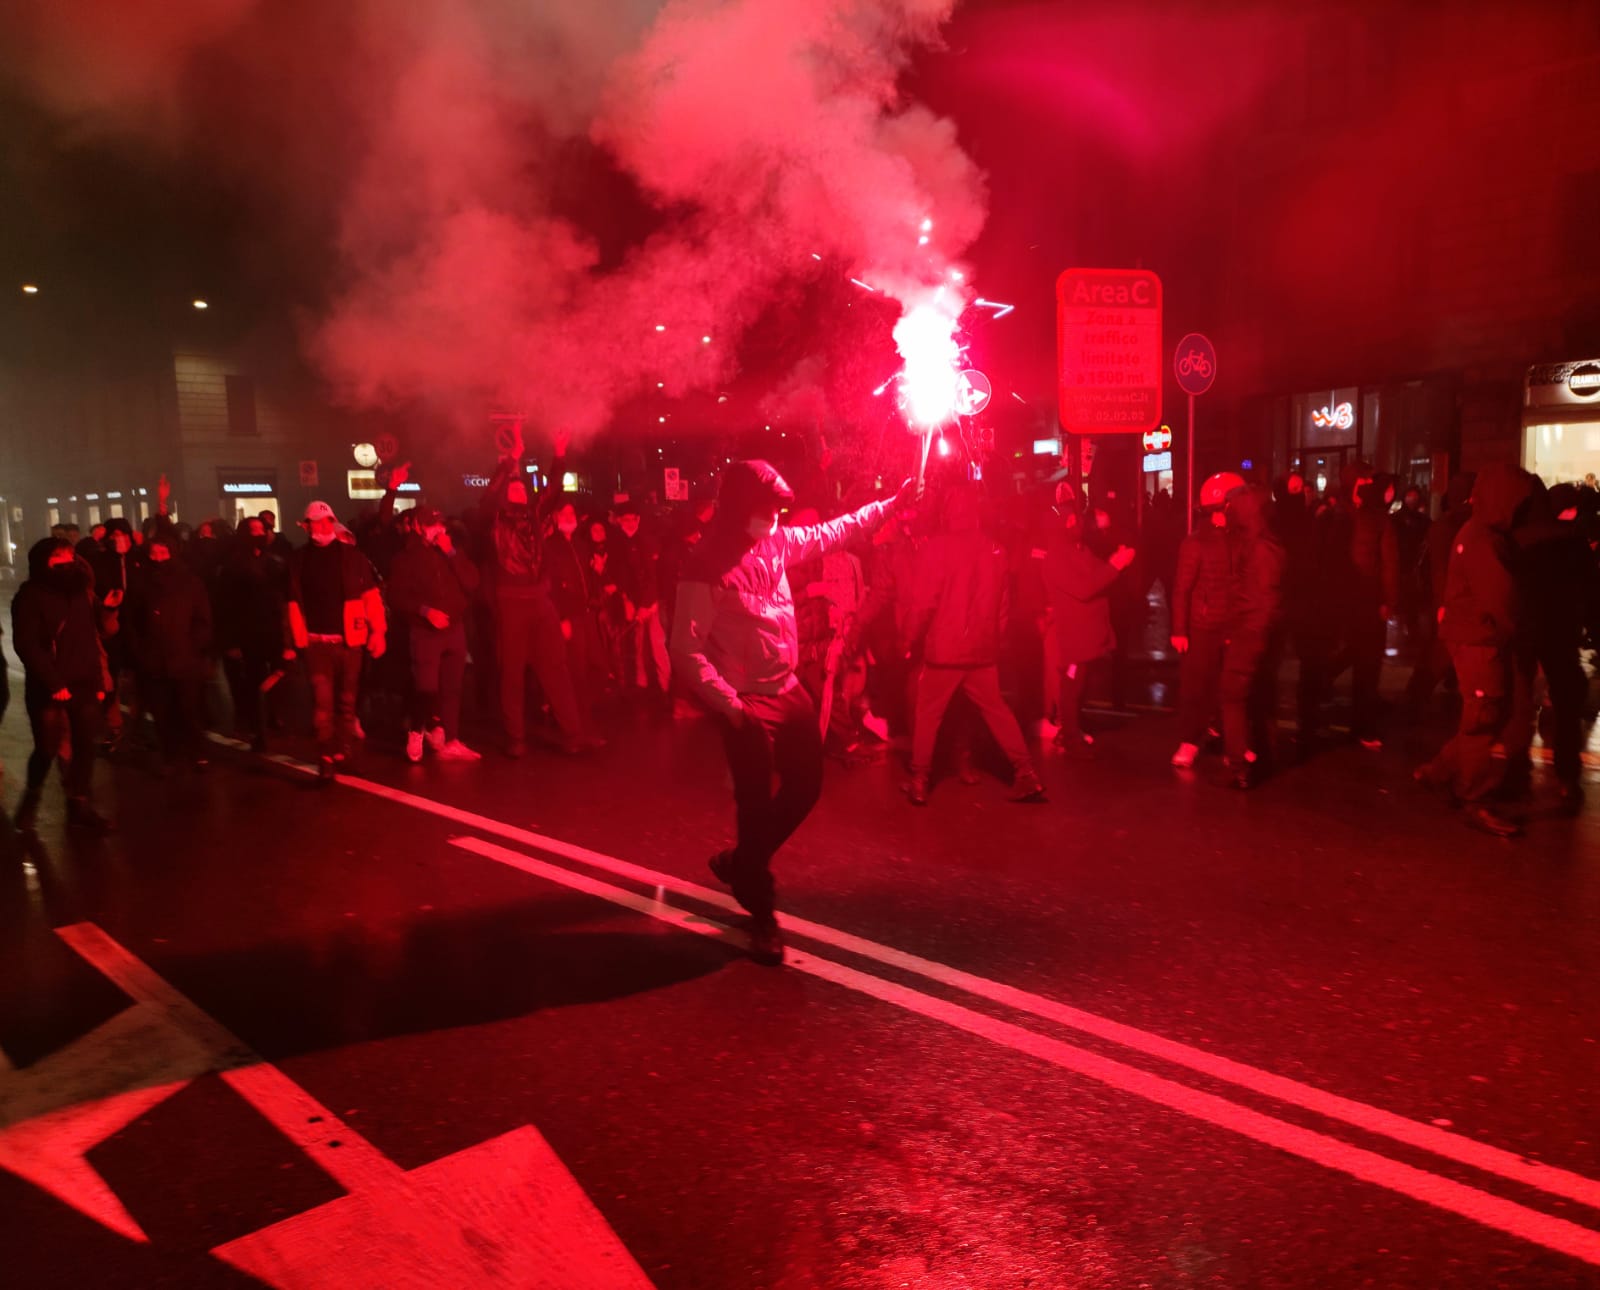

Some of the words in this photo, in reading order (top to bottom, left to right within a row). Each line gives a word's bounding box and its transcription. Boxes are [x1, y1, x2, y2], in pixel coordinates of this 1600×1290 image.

[1086, 311, 1123, 326] Zona
[1128, 315, 1136, 325] a
[1084, 331, 1139, 345] traffico
[1081, 351, 1141, 366] limitato
[1077, 374, 1085, 384] a
[1089, 371, 1123, 385] 1500
[1127, 371, 1145, 384] mt
[1095, 410, 1145, 421] 02.02.02
